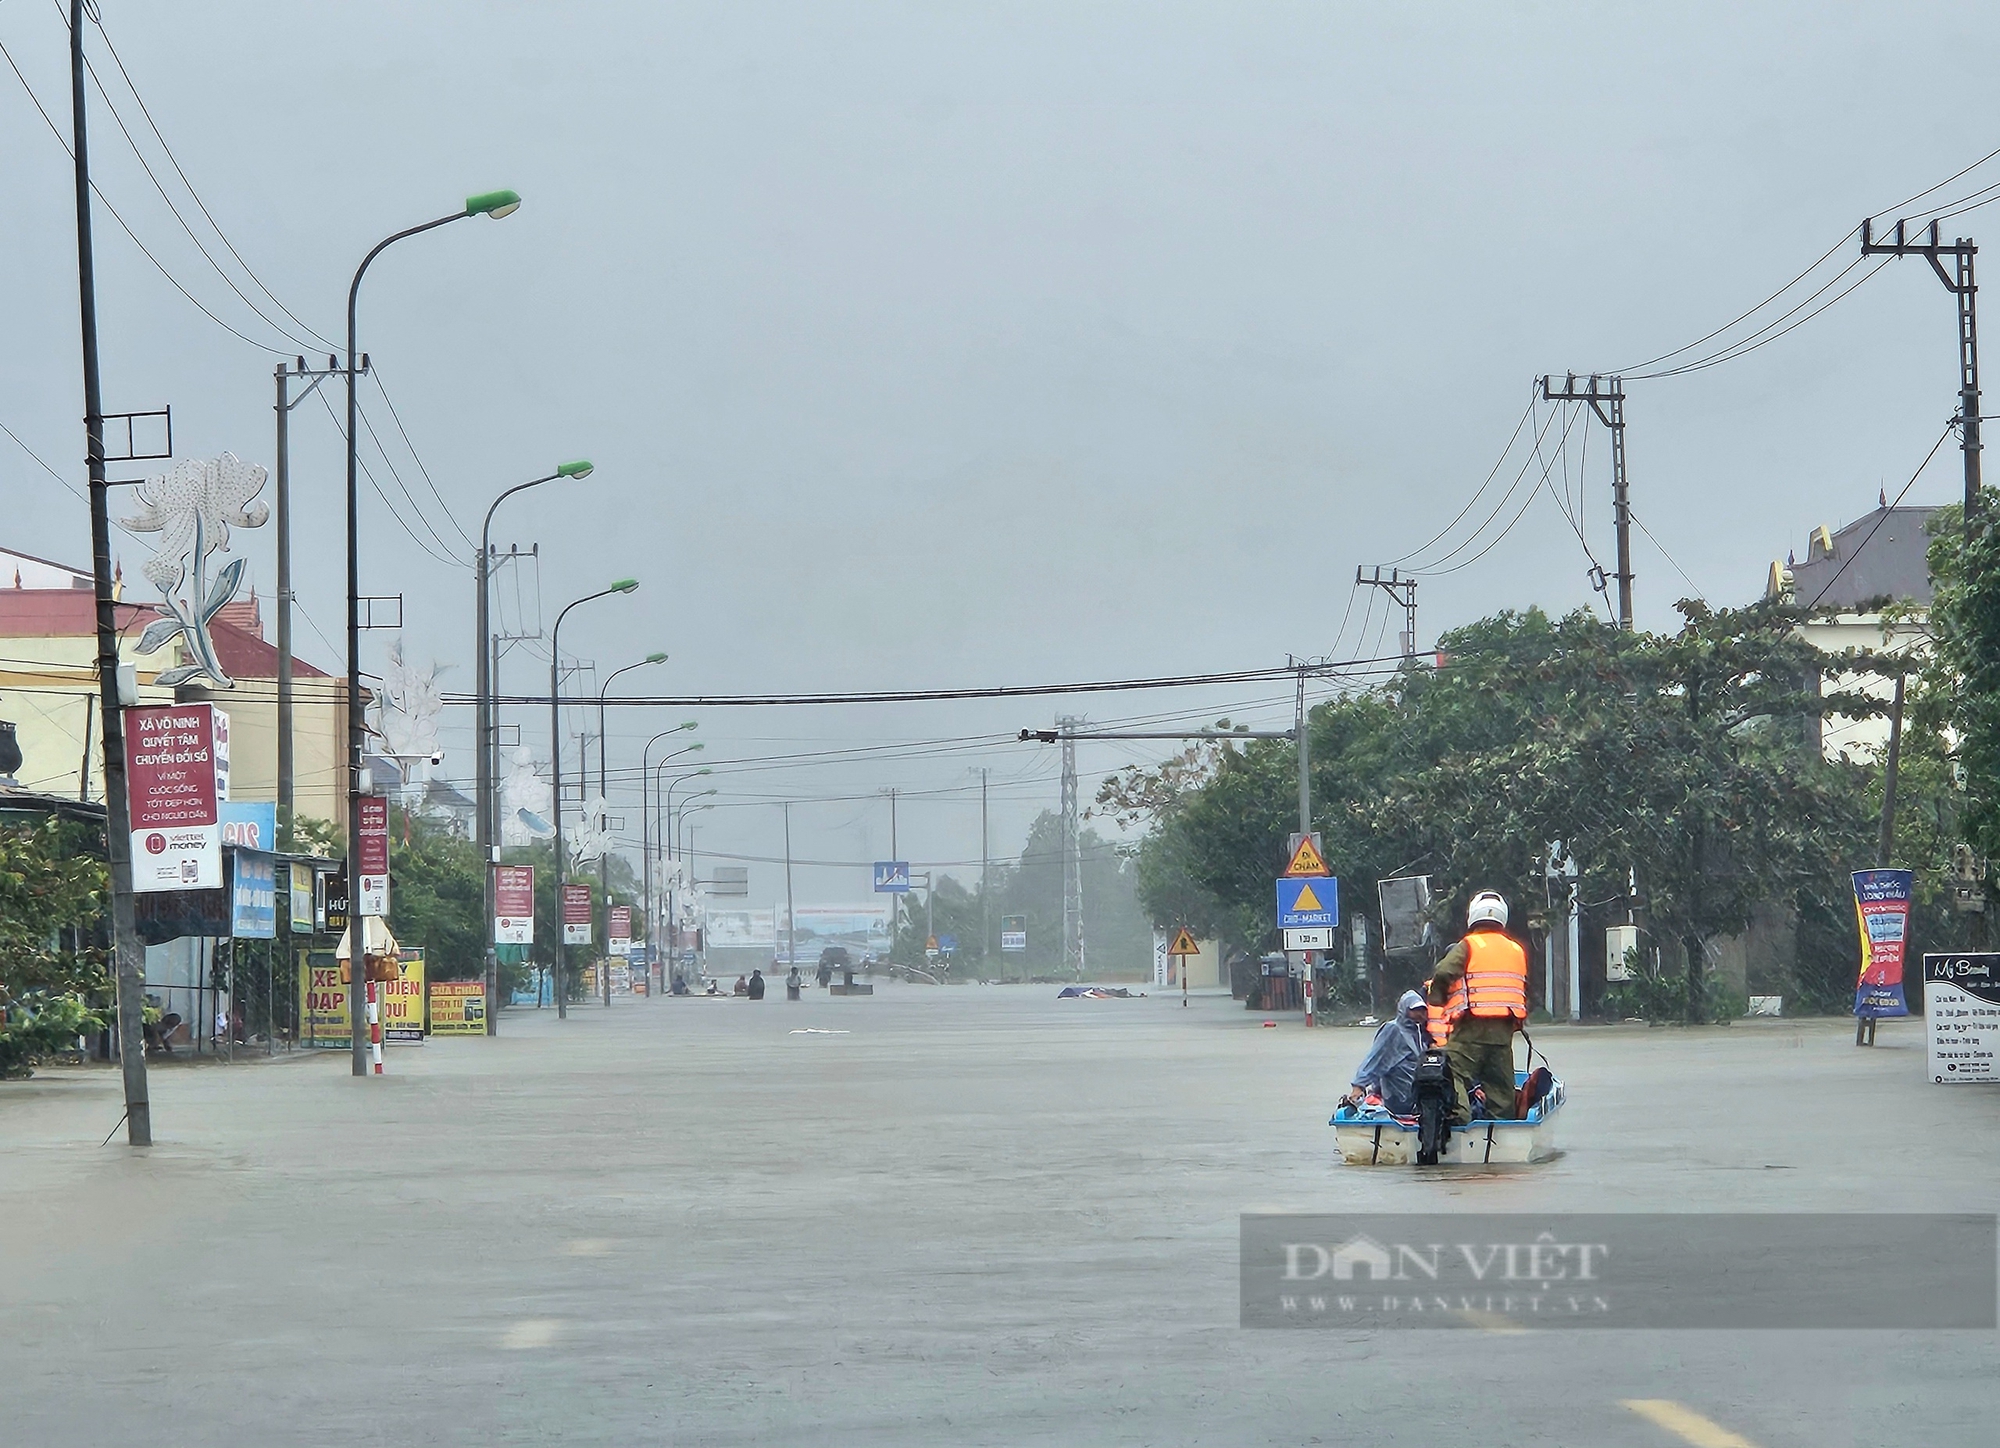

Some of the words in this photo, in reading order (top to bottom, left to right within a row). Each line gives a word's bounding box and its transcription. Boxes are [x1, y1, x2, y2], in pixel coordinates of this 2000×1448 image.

[173, 717, 200, 729] NINH
[142, 732, 176, 748] QUYẾT
[177, 733, 199, 746] TÂM
[194, 746, 208, 762] SỐ
[169, 832, 204, 841] viettel
[169, 841, 207, 851] money
[313, 970, 337, 988] XE
